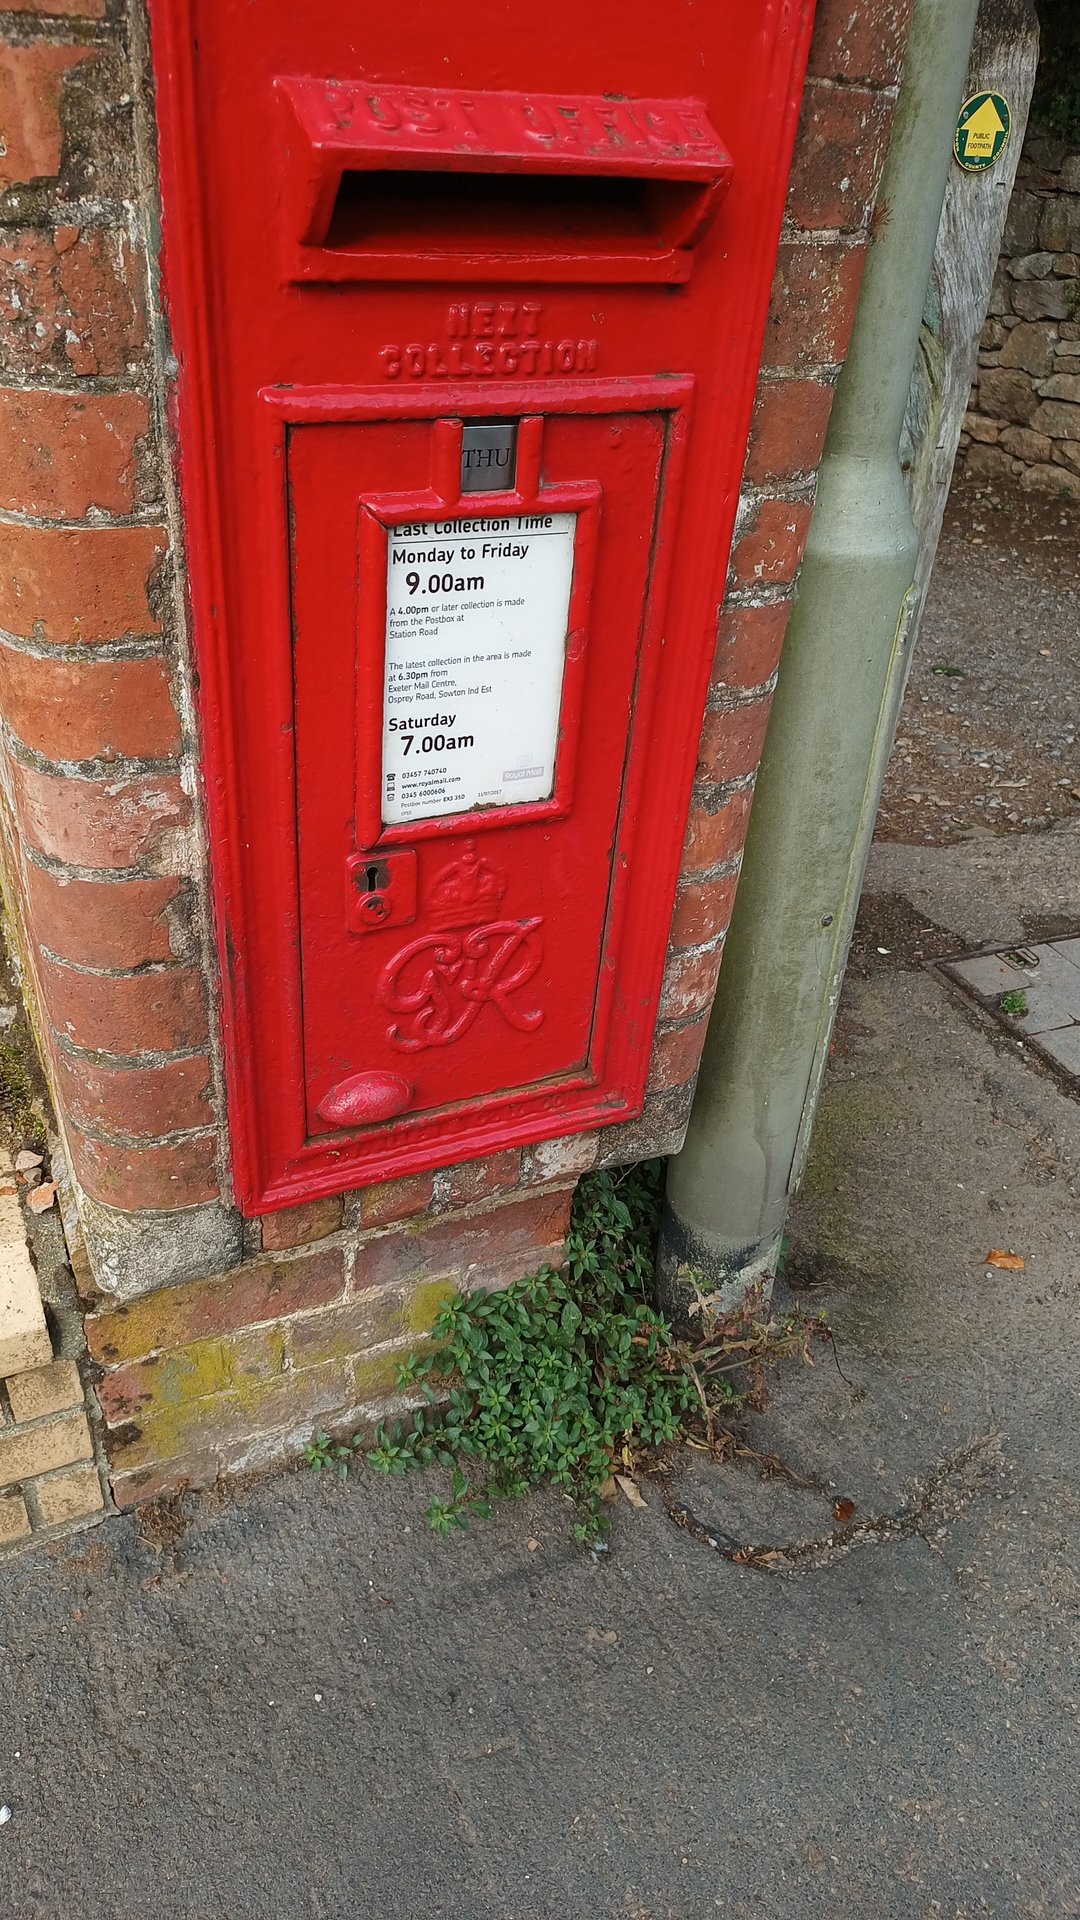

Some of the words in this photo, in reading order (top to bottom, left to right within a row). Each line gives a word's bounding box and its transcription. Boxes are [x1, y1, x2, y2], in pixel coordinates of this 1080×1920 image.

[314, 93, 475, 139] POST
[521, 103, 718, 152] OFFICE
[972, 132, 990, 140] PUBLIC
[967, 142, 992, 150] FOOTPATH
[448, 302, 544, 340] NEXT
[378, 338, 598, 378] COLLECTION
[462, 447, 511, 469] THU
[393, 523, 428, 537] Last
[434, 517, 510, 535] Collection
[515, 515, 553, 530] Time
[392, 548, 454, 565] Monday
[460, 547, 475, 560] to
[482, 543, 529, 560] Friday
[405, 571, 485, 595] 9.00am
[389, 608, 396, 616] A
[398, 606, 429, 616] 4.00pm
[441, 604, 458, 612] later
[460, 600, 495, 611] collection
[504, 598, 525, 606] made
[389, 619, 408, 628] from
[411, 618, 423, 626] the
[425, 615, 455, 625] Postbox
[457, 614, 464, 622] at
[389, 630, 417, 639] Station
[419, 627, 438, 637] Road
[389, 662, 403, 671] The
[405, 660, 426, 670] latest
[428, 657, 462, 667] collection
[472, 653, 485, 662] the
[486, 653, 502, 661] area
[504, 650, 510, 659] is
[511, 649, 532, 658] made
[388, 674, 396, 682] at
[398, 671, 429, 681] 6.30pm
[430, 669, 448, 677] from
[388, 684, 411, 693] Exeter
[414, 681, 430, 690] Mail
[431, 679, 457, 688] Centre,
[388, 695, 414, 704] Osprey
[416, 691, 437, 701] Road,
[438, 688, 466, 698] Sowton
[468, 687, 479, 695] Ind
[481, 685, 492, 694] Est
[388, 713, 457, 732] Saturday
[400, 734, 474, 756] 7.00am
[401, 770, 422, 779] 03457
[424, 767, 447, 777] 740740
[504, 770, 525, 780] Royal
[526, 768, 543, 777] Mail
[401, 776, 461, 789] www.royalmail.com
[401, 791, 417, 800] 0345
[418, 787, 446, 797] 6000606
